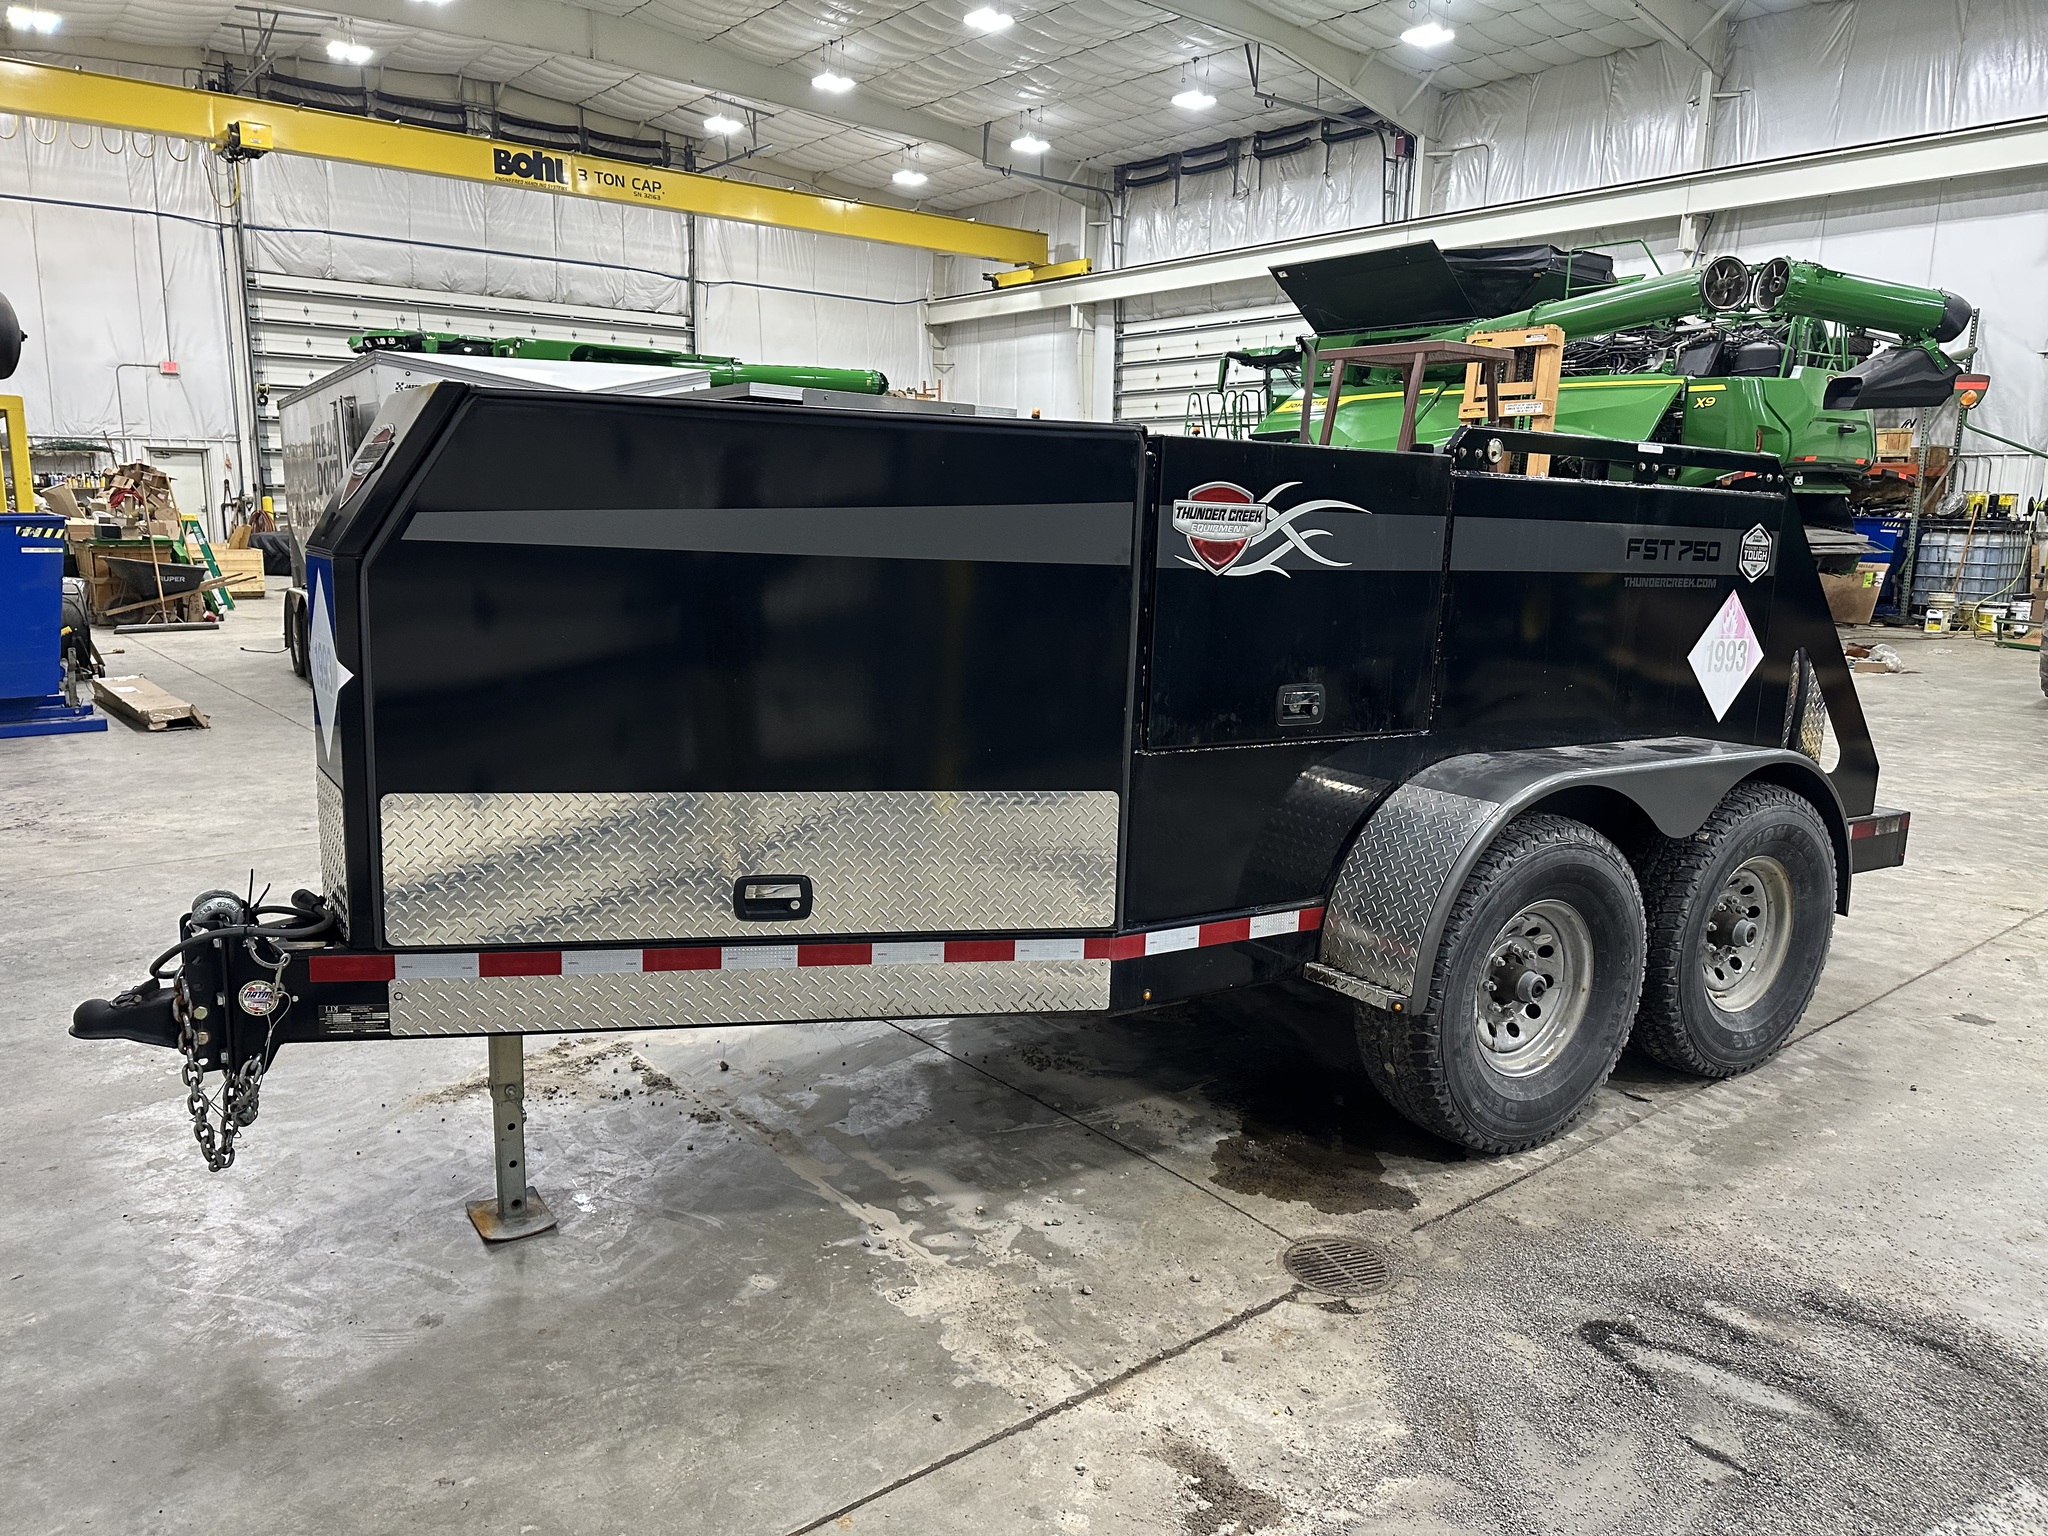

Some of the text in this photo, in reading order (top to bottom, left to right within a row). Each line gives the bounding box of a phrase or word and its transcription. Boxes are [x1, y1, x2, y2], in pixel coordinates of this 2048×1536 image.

[493, 148, 568, 185] Bohl
[578, 169, 666, 195] 3 TON CAP.
[1693, 396, 1716, 408] X9
[310, 422, 327, 460] THE
[1176, 506, 1264, 523] THUNDER CREEK
[1190, 522, 1248, 533] EQUIPMENT
[1626, 538, 1721, 562] FST 750
[1744, 549, 1768, 561] TOUGH
[1624, 577, 1717, 588] THUNDERCREEK.COM
[1707, 640, 1747, 673] 1993
